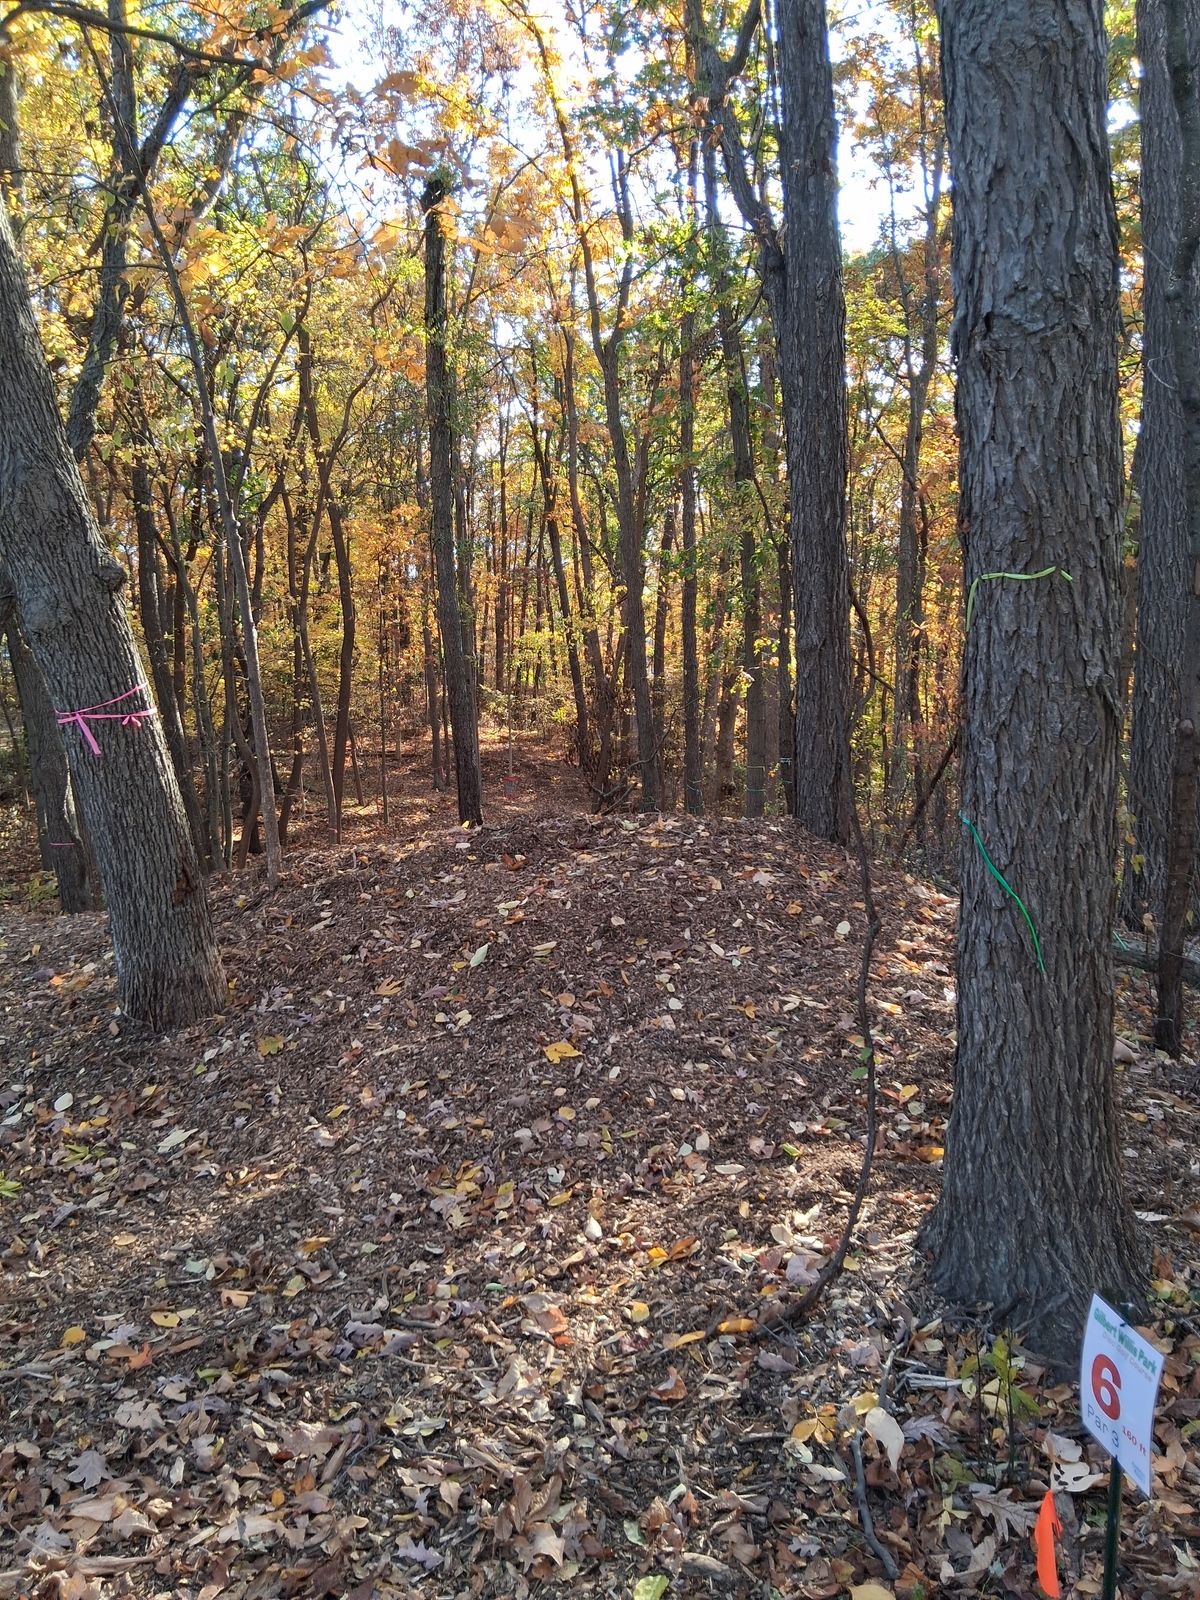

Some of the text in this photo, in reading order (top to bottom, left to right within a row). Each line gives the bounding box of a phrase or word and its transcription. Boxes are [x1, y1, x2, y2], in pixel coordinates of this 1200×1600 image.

[1138, 1349, 1157, 1377] Park
[1092, 1353, 1121, 1420] 6
[1087, 1403, 1120, 1448] Par 3
